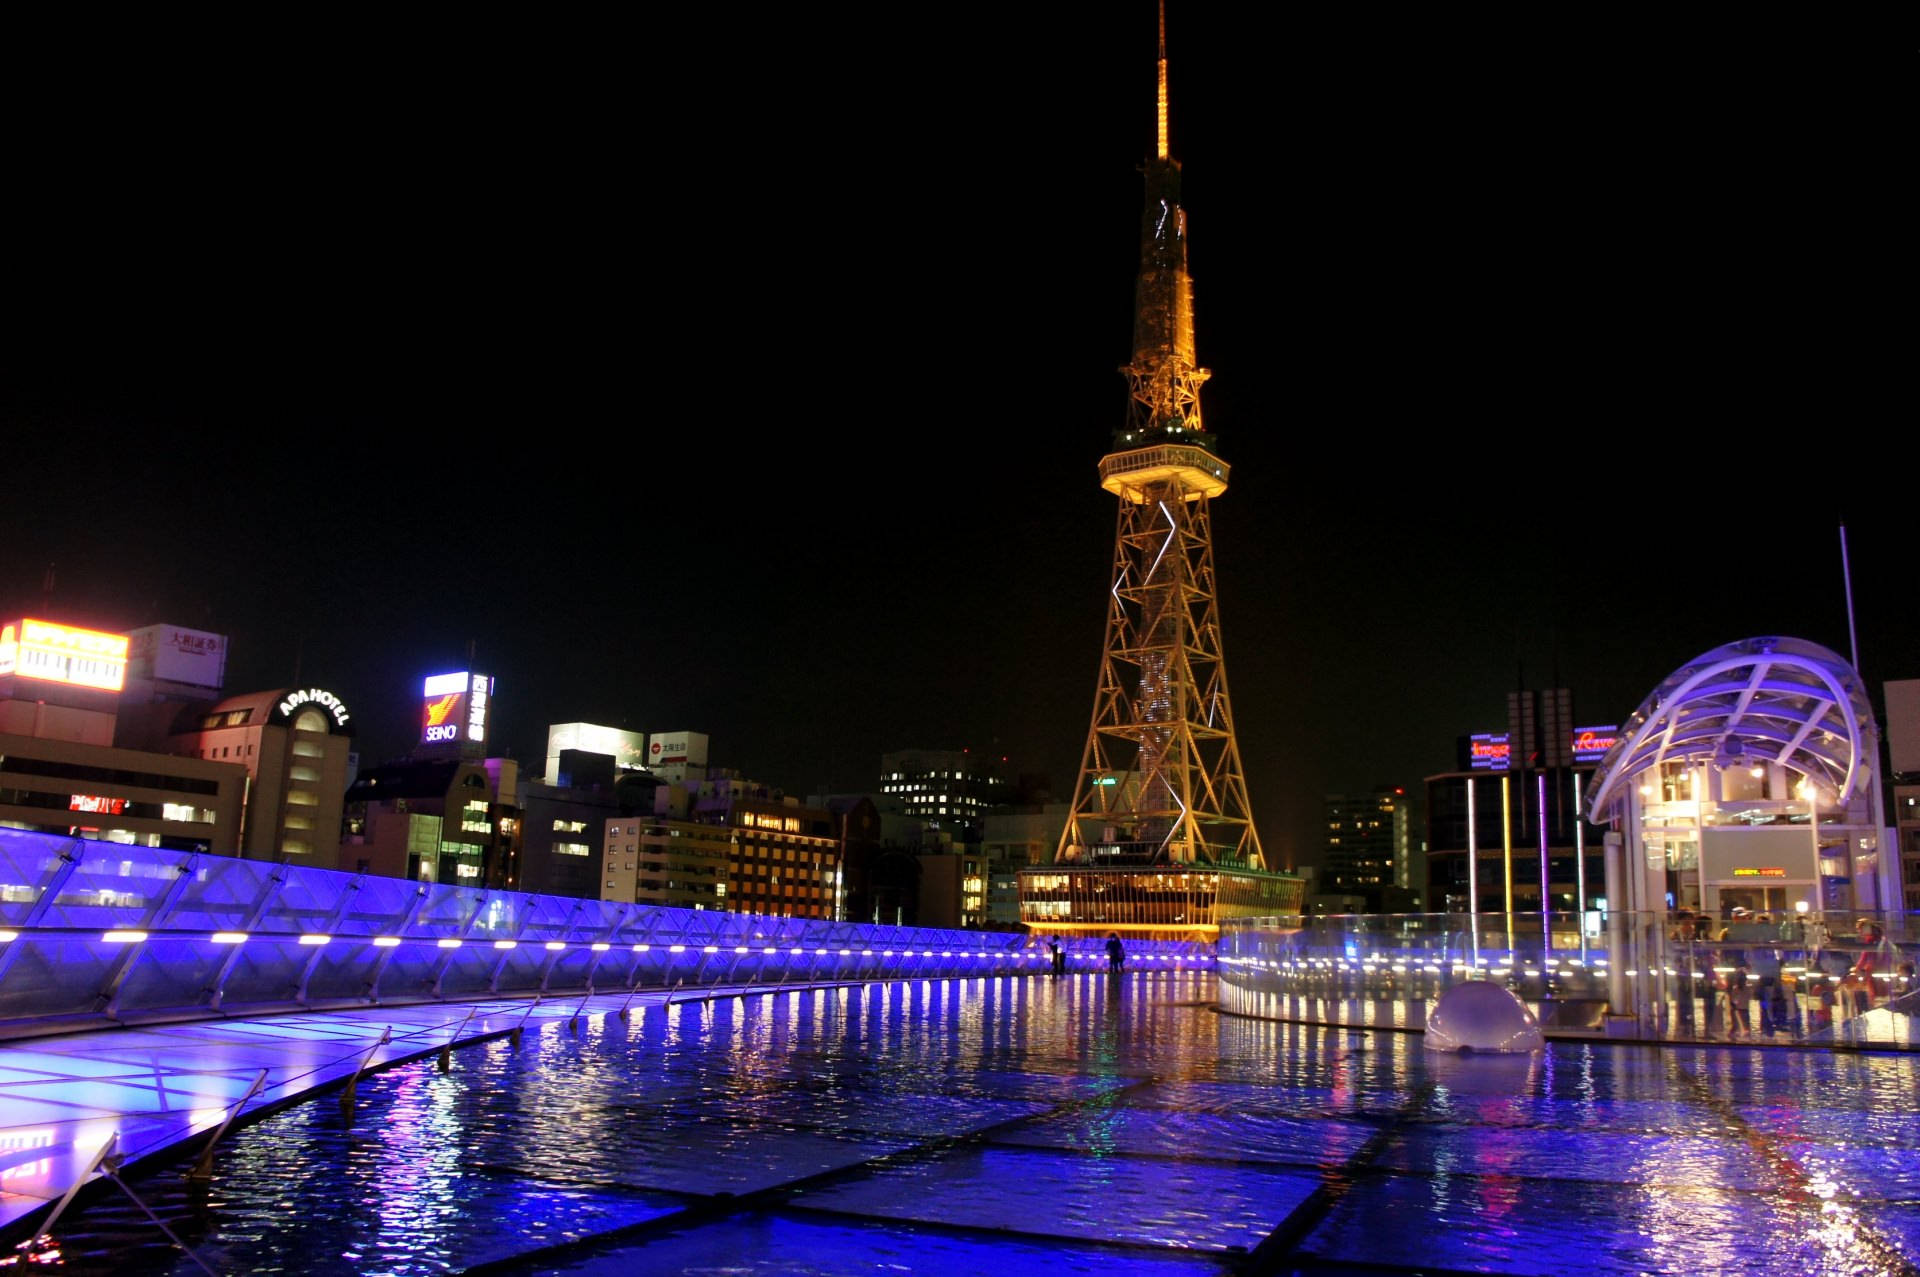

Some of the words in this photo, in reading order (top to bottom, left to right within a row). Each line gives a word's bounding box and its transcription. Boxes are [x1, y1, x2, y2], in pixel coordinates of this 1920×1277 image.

[280, 689, 309, 716] APA
[309, 688, 350, 726] HOTEL
[426, 725, 457, 741] SEINO
